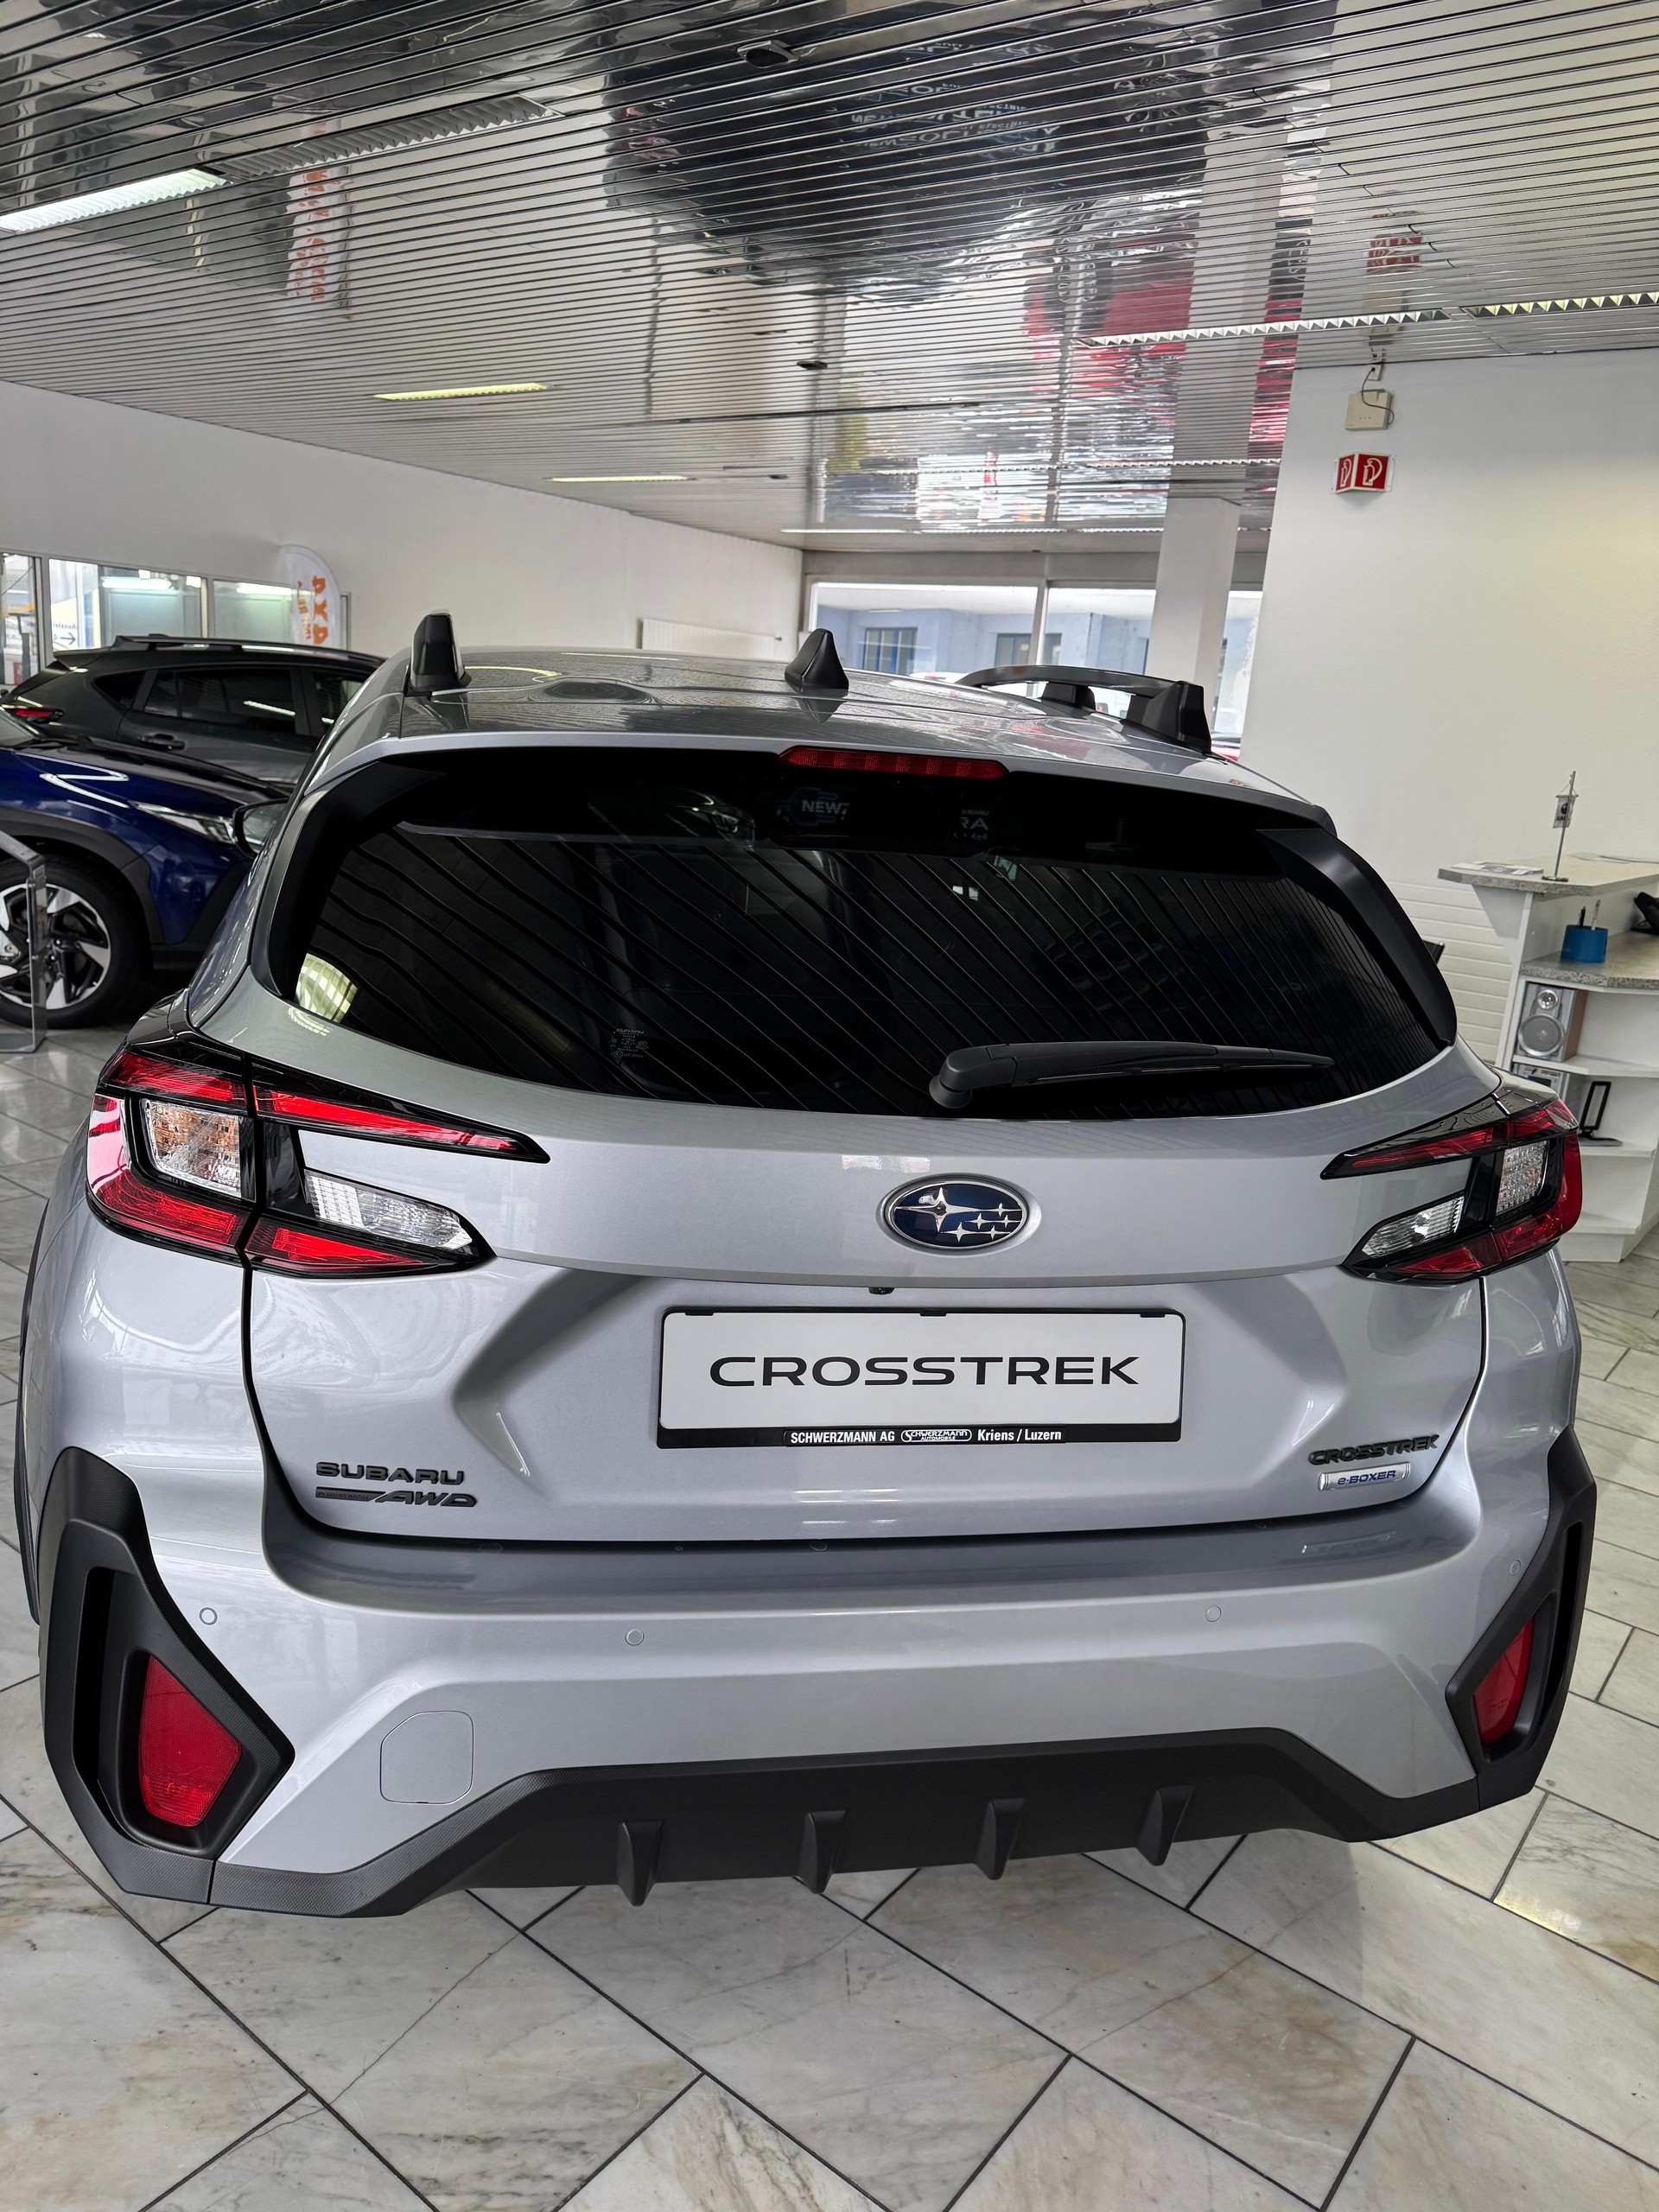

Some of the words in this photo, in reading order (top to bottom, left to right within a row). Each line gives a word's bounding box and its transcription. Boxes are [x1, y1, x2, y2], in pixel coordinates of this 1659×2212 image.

[709, 1356, 1140, 1386] CROSSTREK
[790, 1431, 876, 1444] SCHWERZMANN
[879, 1431, 895, 1442] AG
[977, 1429, 1014, 1441] Kriens
[1024, 1428, 1062, 1440] Luzern
[1308, 1434, 1440, 1465] CROSSTREK
[316, 1462, 464, 1485] SUBARU
[1338, 1470, 1396, 1484] e-BOXER
[375, 1491, 479, 1508] AWD
